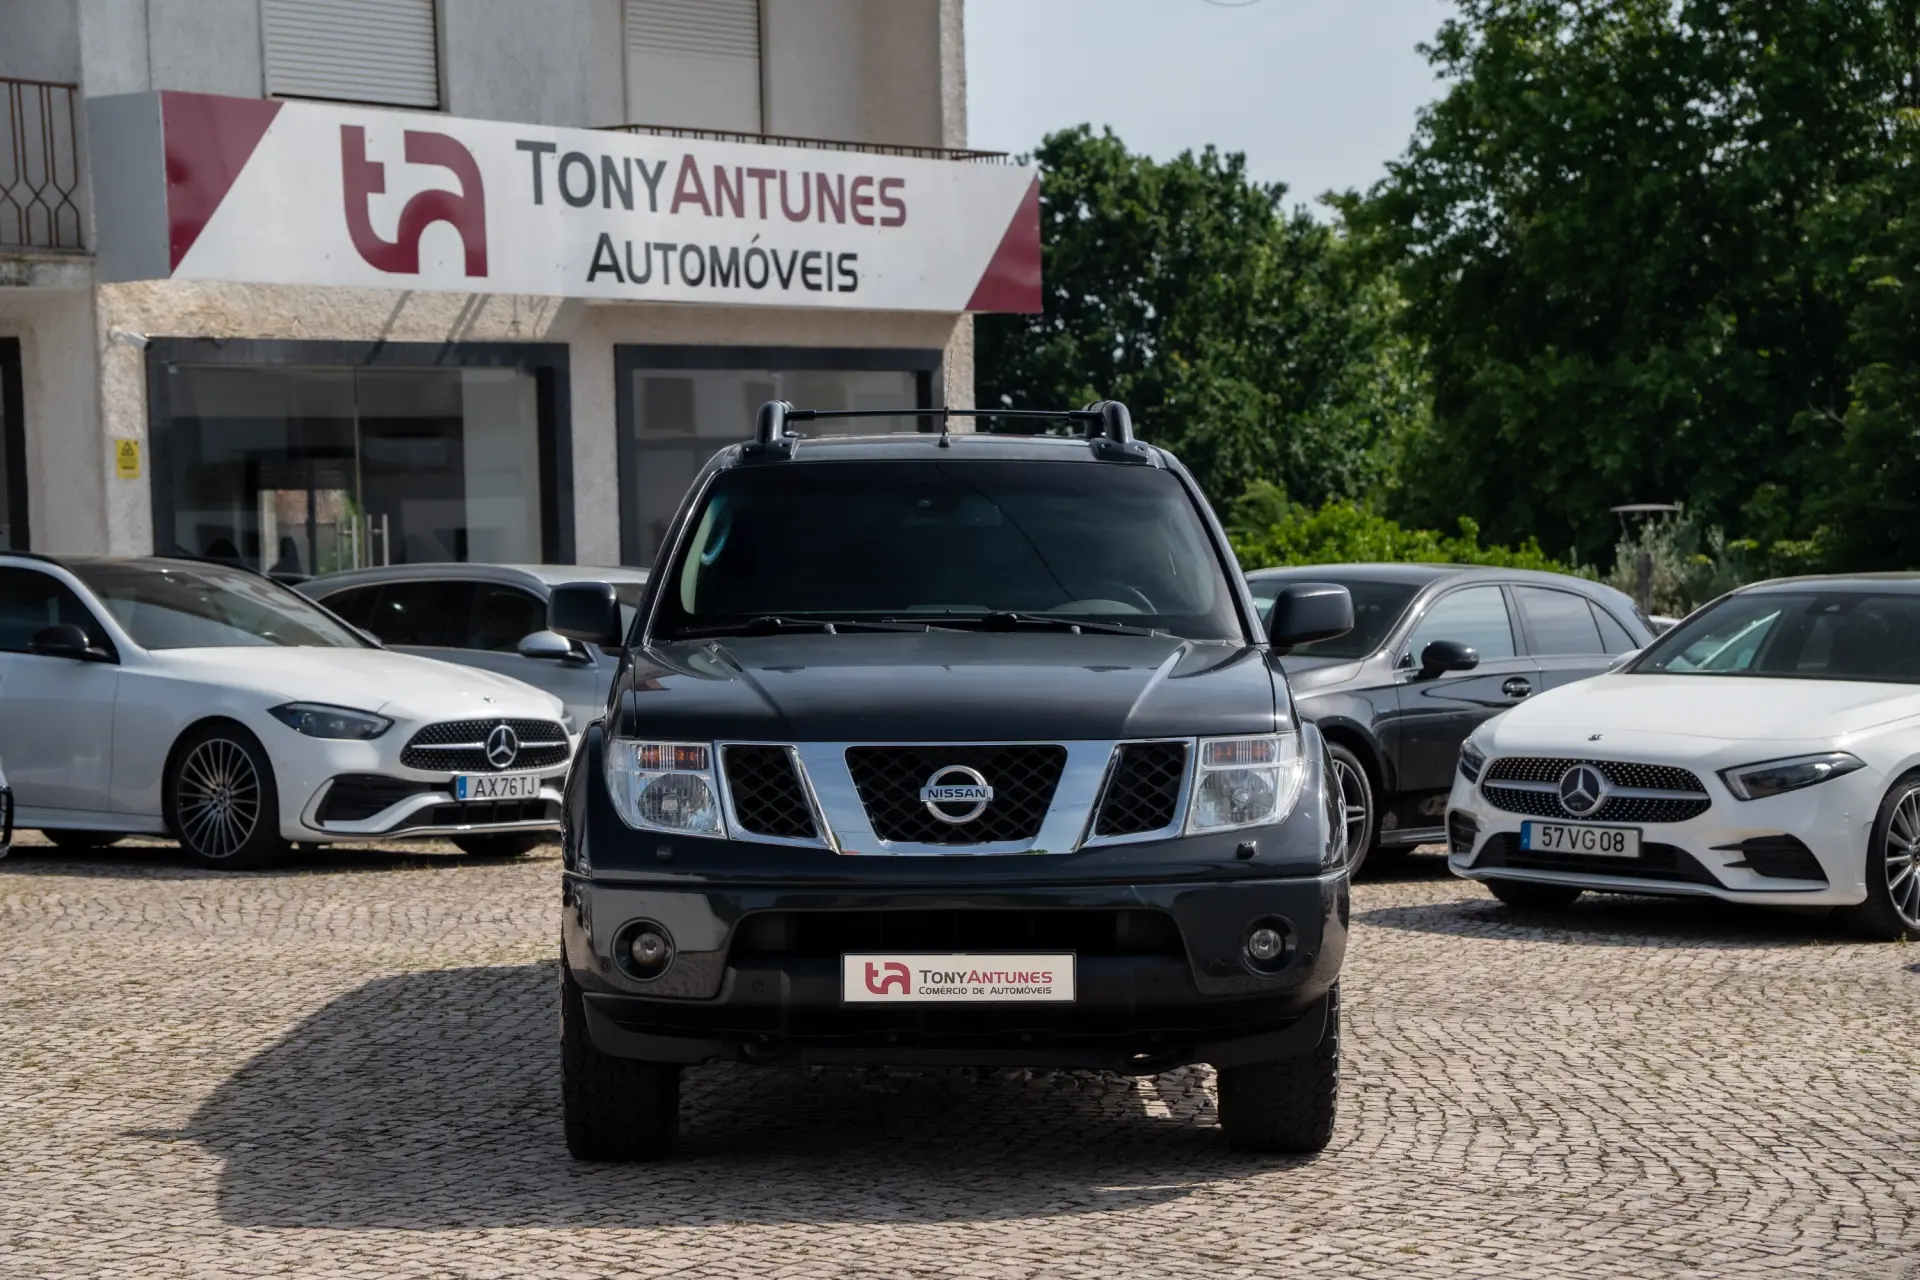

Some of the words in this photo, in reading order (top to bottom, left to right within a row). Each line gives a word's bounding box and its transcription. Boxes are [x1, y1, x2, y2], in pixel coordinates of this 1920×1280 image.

[586, 232, 858, 292] AUTOMÓVEIS
[474, 777, 534, 797] AX76TJ
[928, 788, 986, 798] NISSAN
[919, 985, 967, 995] COMÉRCIO
[972, 987, 985, 995] DE
[990, 985, 1052, 995] AUTOMÓVEIS
